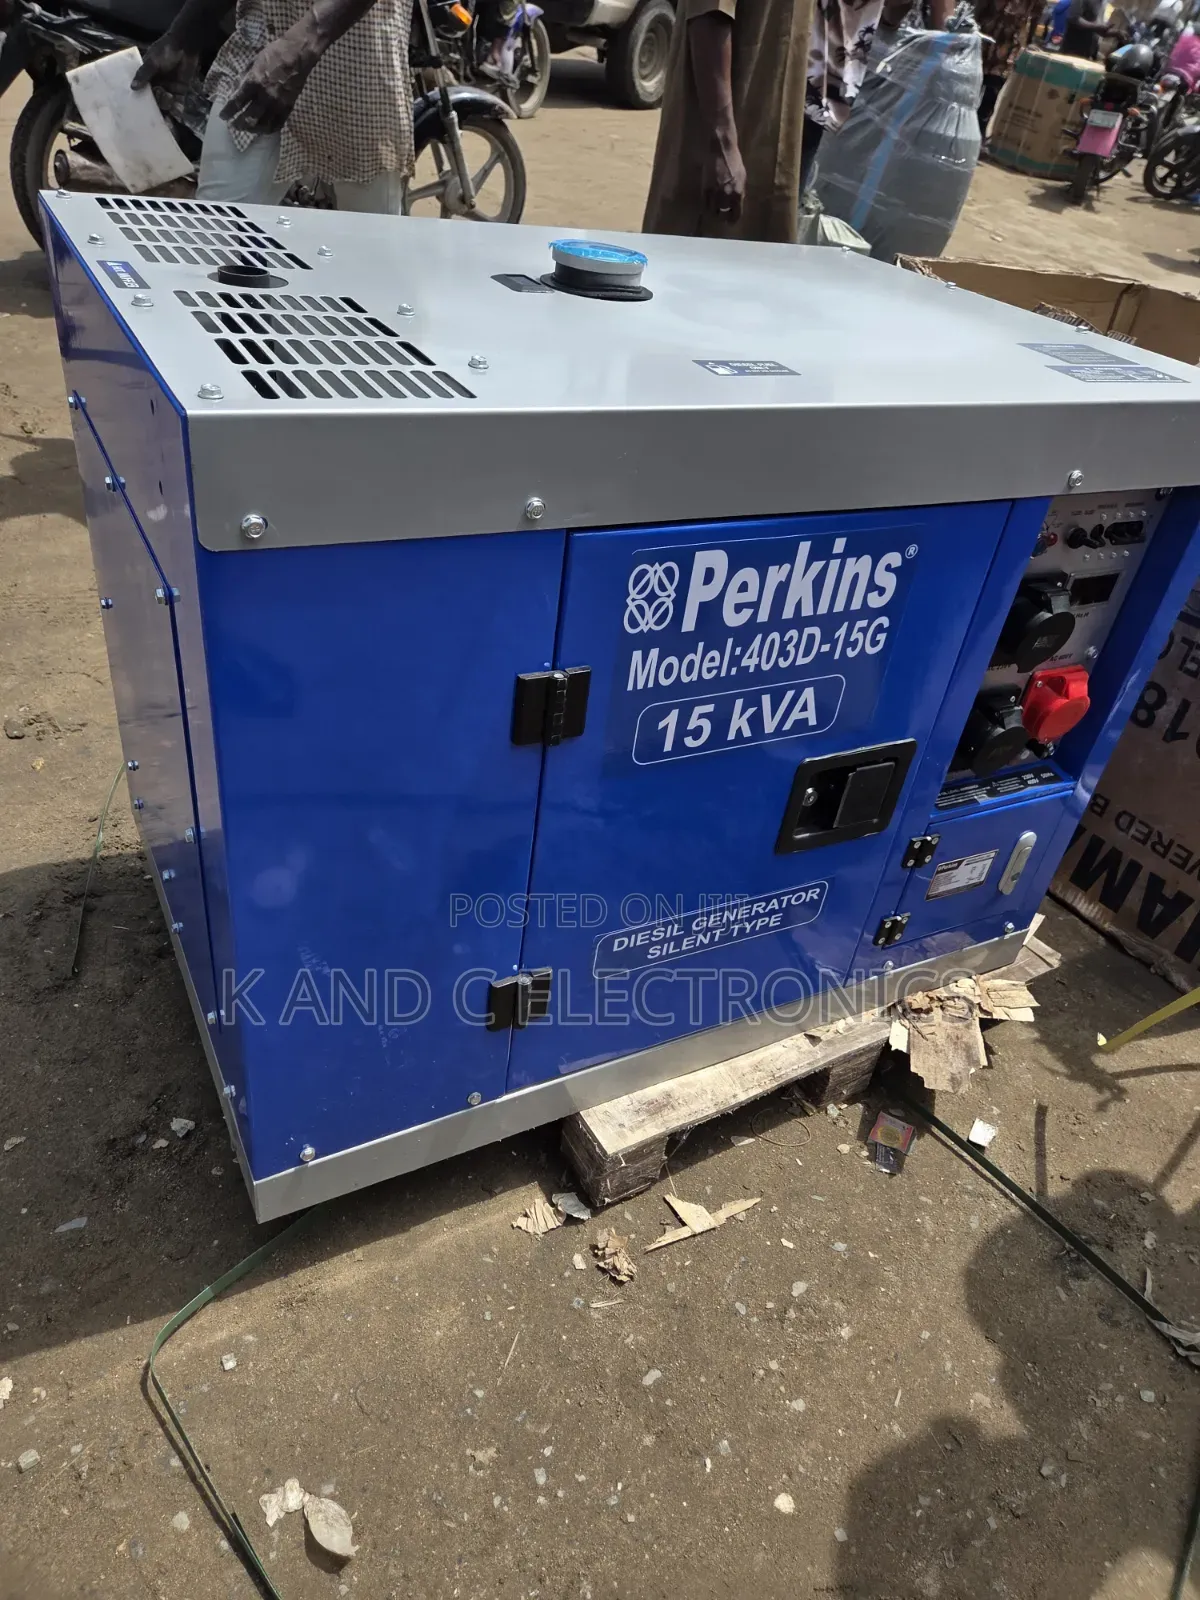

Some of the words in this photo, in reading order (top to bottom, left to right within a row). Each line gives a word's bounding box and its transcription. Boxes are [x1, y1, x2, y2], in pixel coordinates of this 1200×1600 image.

[626, 616, 890, 691] Model:403D-15G
[656, 703, 716, 752] 15
[726, 686, 818, 741] kVA
[612, 924, 685, 952] DIESIL
[691, 888, 821, 931] GENERATOR
[647, 928, 726, 960] SILENT
[730, 913, 783, 938] TYPE
